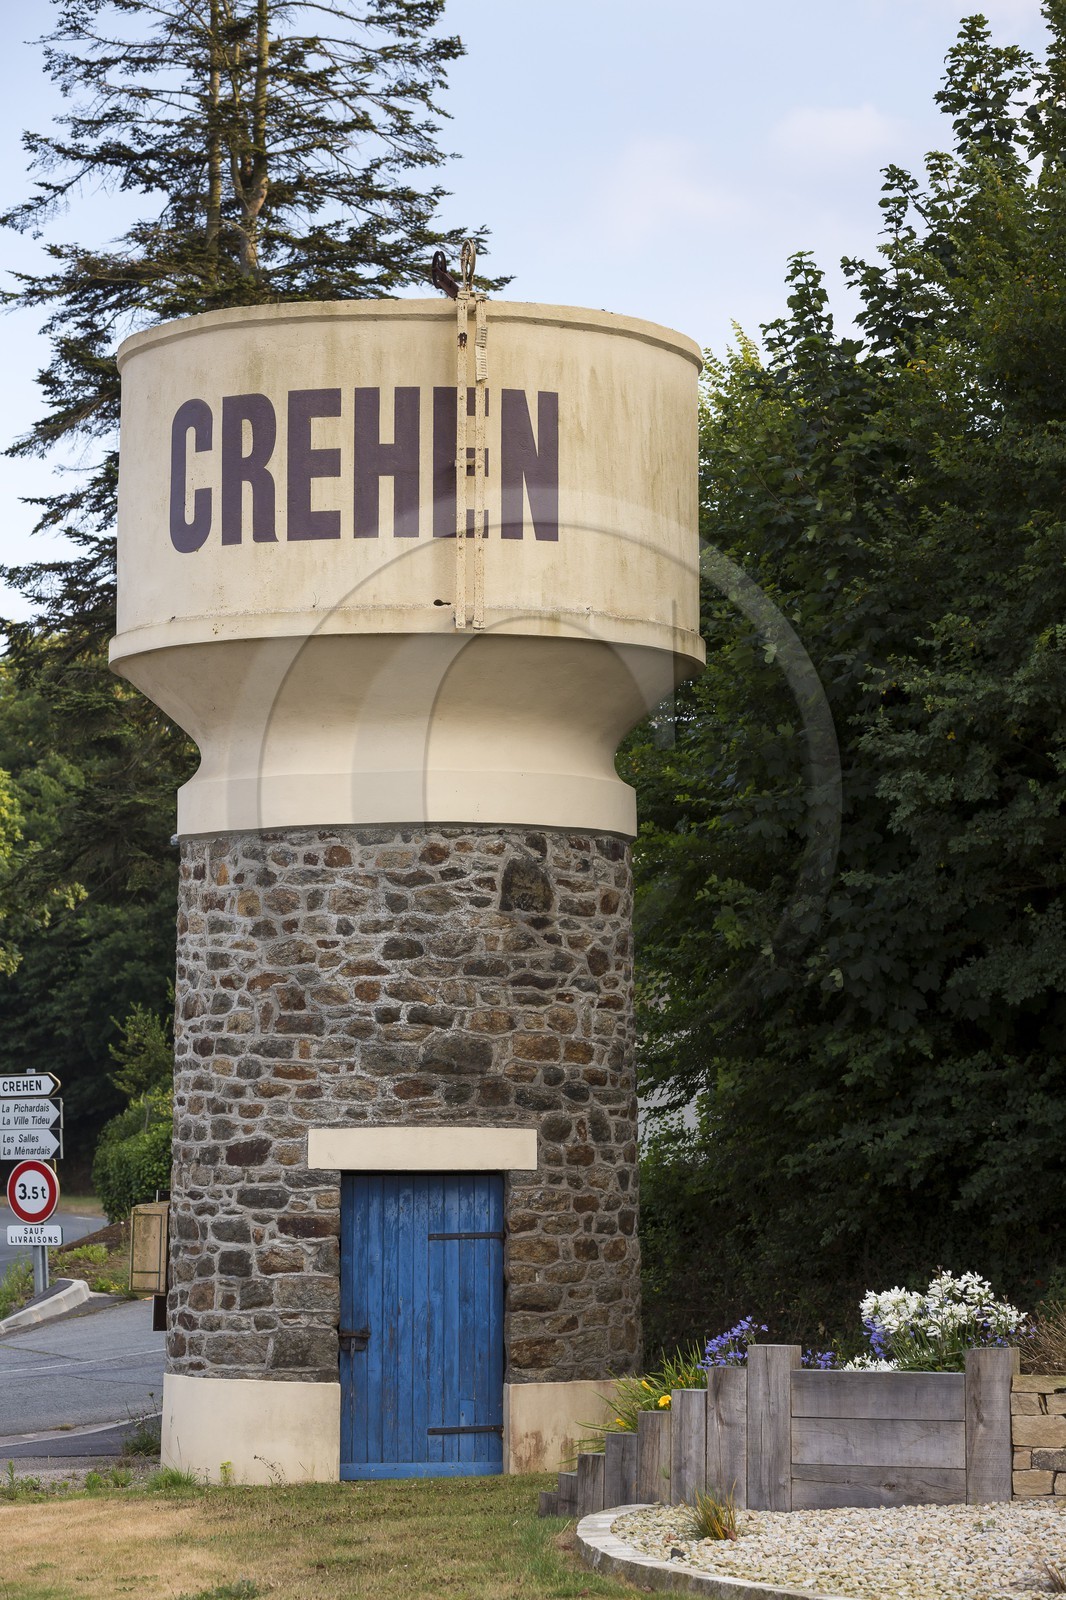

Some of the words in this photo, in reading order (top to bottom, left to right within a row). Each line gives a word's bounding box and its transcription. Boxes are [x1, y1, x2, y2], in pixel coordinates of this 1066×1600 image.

[169, 386, 559, 554] CREHEN
[2, 1080, 42, 1092] CREHEN
[2, 1104, 10, 1113] La
[14, 1103, 50, 1112] Pichardais
[2, 1116, 11, 1125] La
[14, 1116, 29, 1125] Ville
[31, 1115, 51, 1125] Tideu
[2, 1134, 15, 1143] Les
[18, 1134, 40, 1143] Salles
[2, 1146, 11, 1156] La
[14, 1145, 51, 1155] Ménardais
[23, 1227, 45, 1235] SAUF
[10, 1236, 59, 1244] LIVRAISONS
